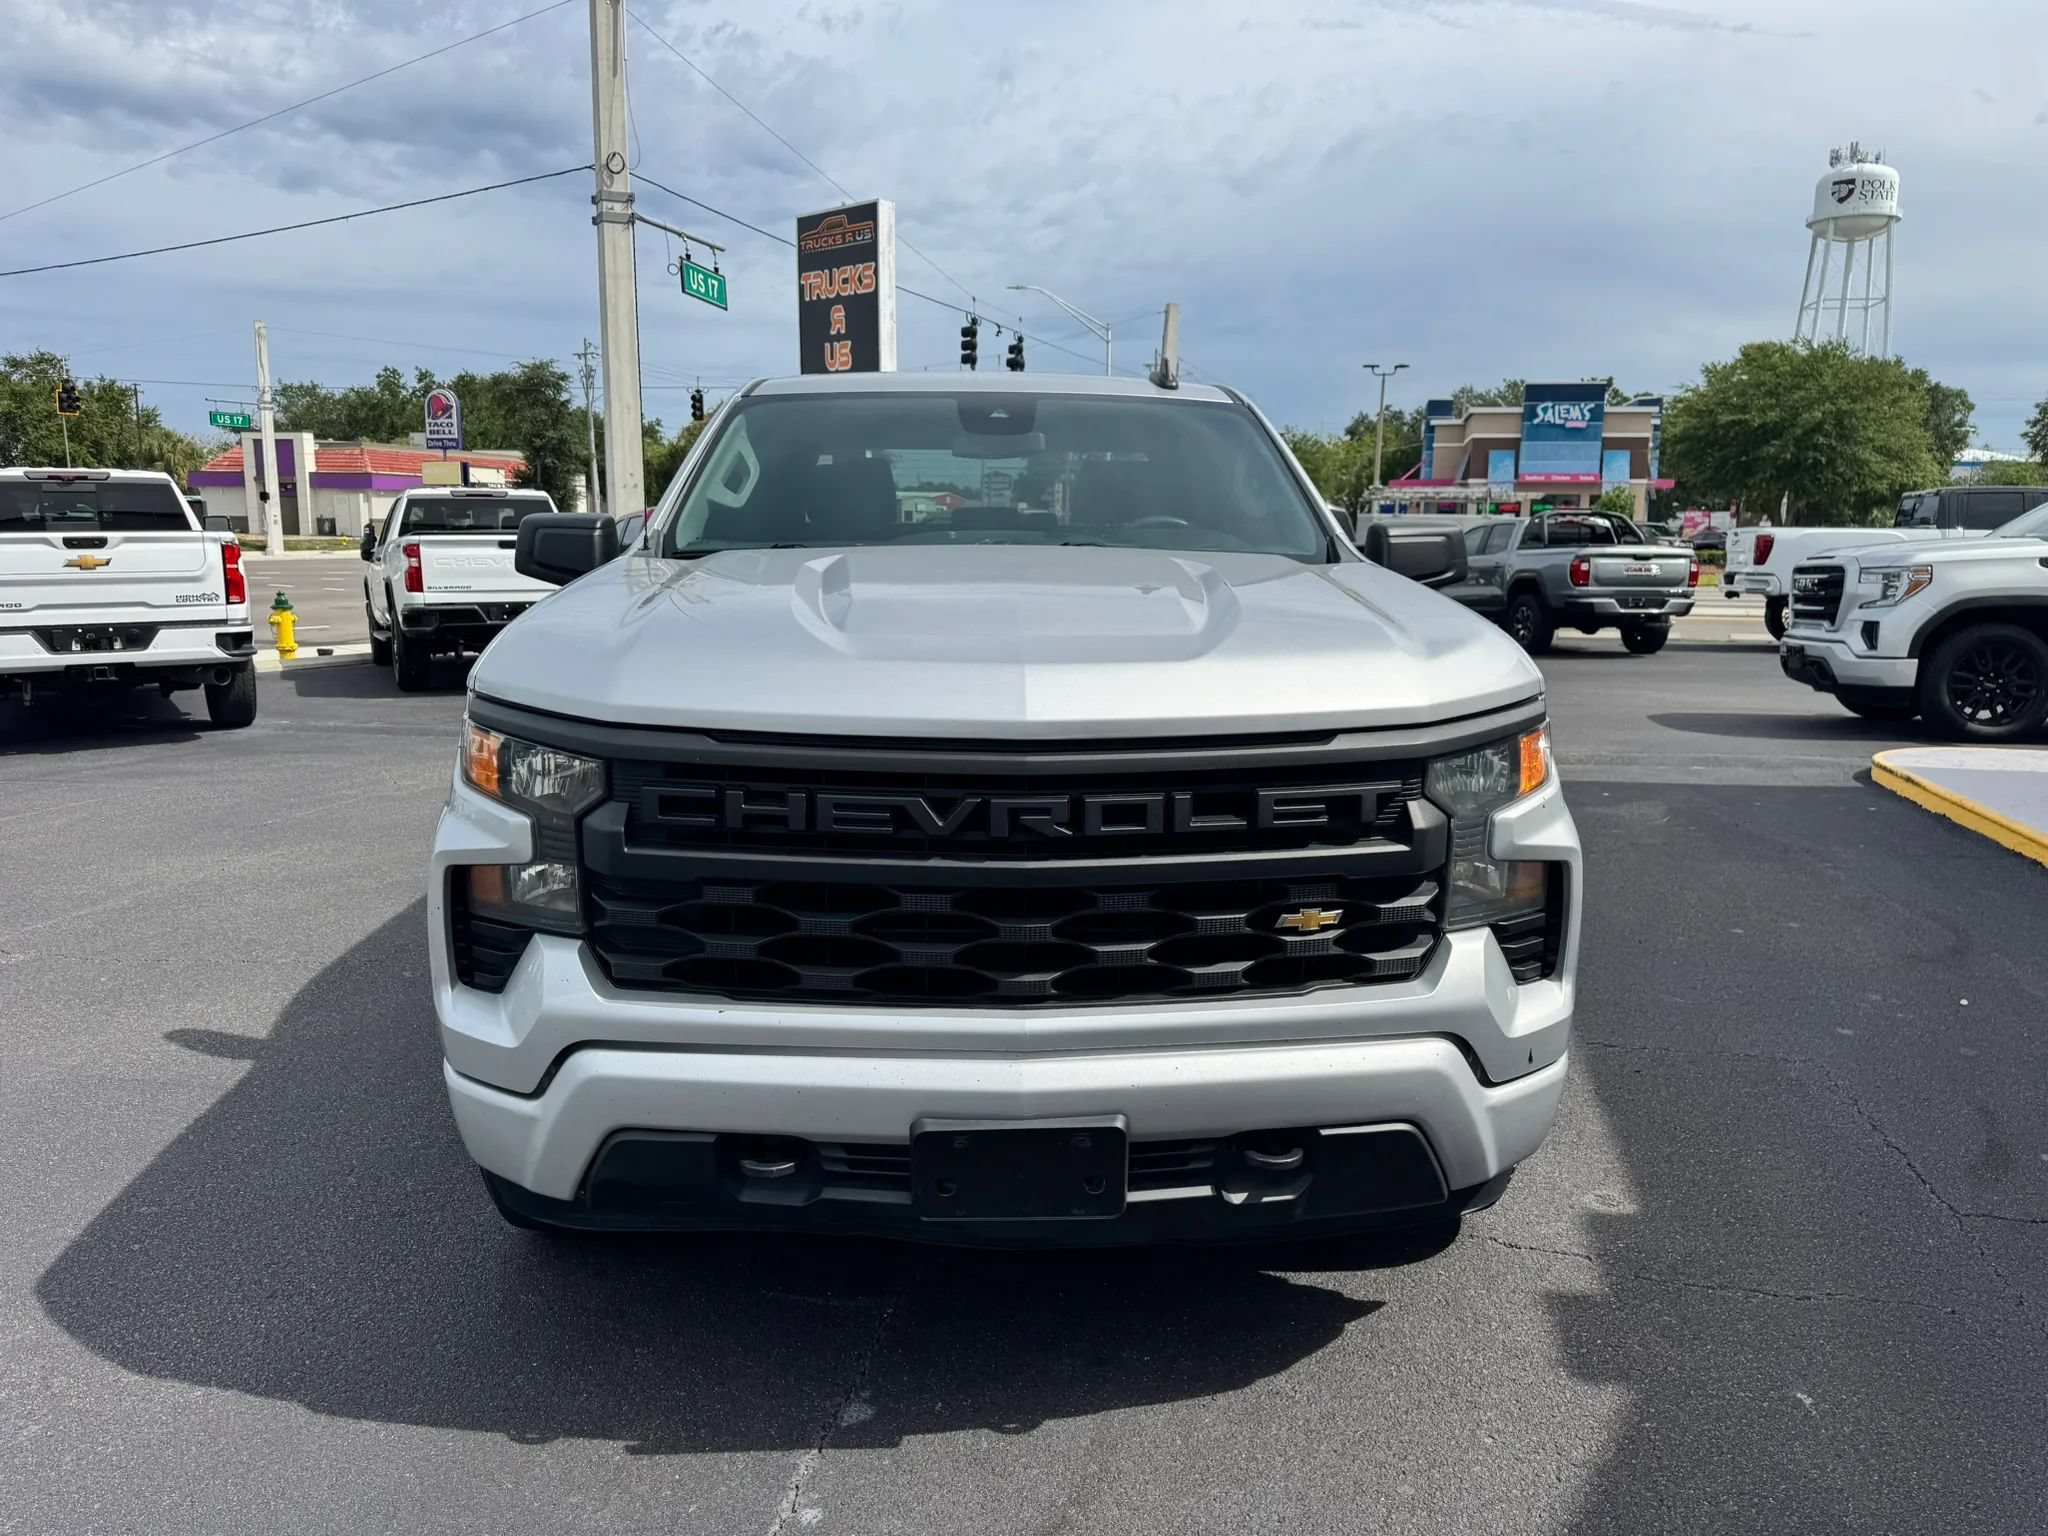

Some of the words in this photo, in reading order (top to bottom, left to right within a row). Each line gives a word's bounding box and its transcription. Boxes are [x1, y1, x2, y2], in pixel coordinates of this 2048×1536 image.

[1858, 189, 1896, 201] STATE
[1861, 179, 1896, 191] POLK
[800, 234, 843, 250] TRUCKS
[855, 229, 872, 240] US
[689, 268, 706, 293] US
[708, 278, 719, 299] 17
[800, 261, 876, 302] TRUCKS
[824, 340, 852, 372] US
[216, 414, 231, 424] US
[233, 416, 243, 425] 17
[1532, 401, 1595, 425] SALEM'S
[641, 779, 1405, 838] CHEVROLET
